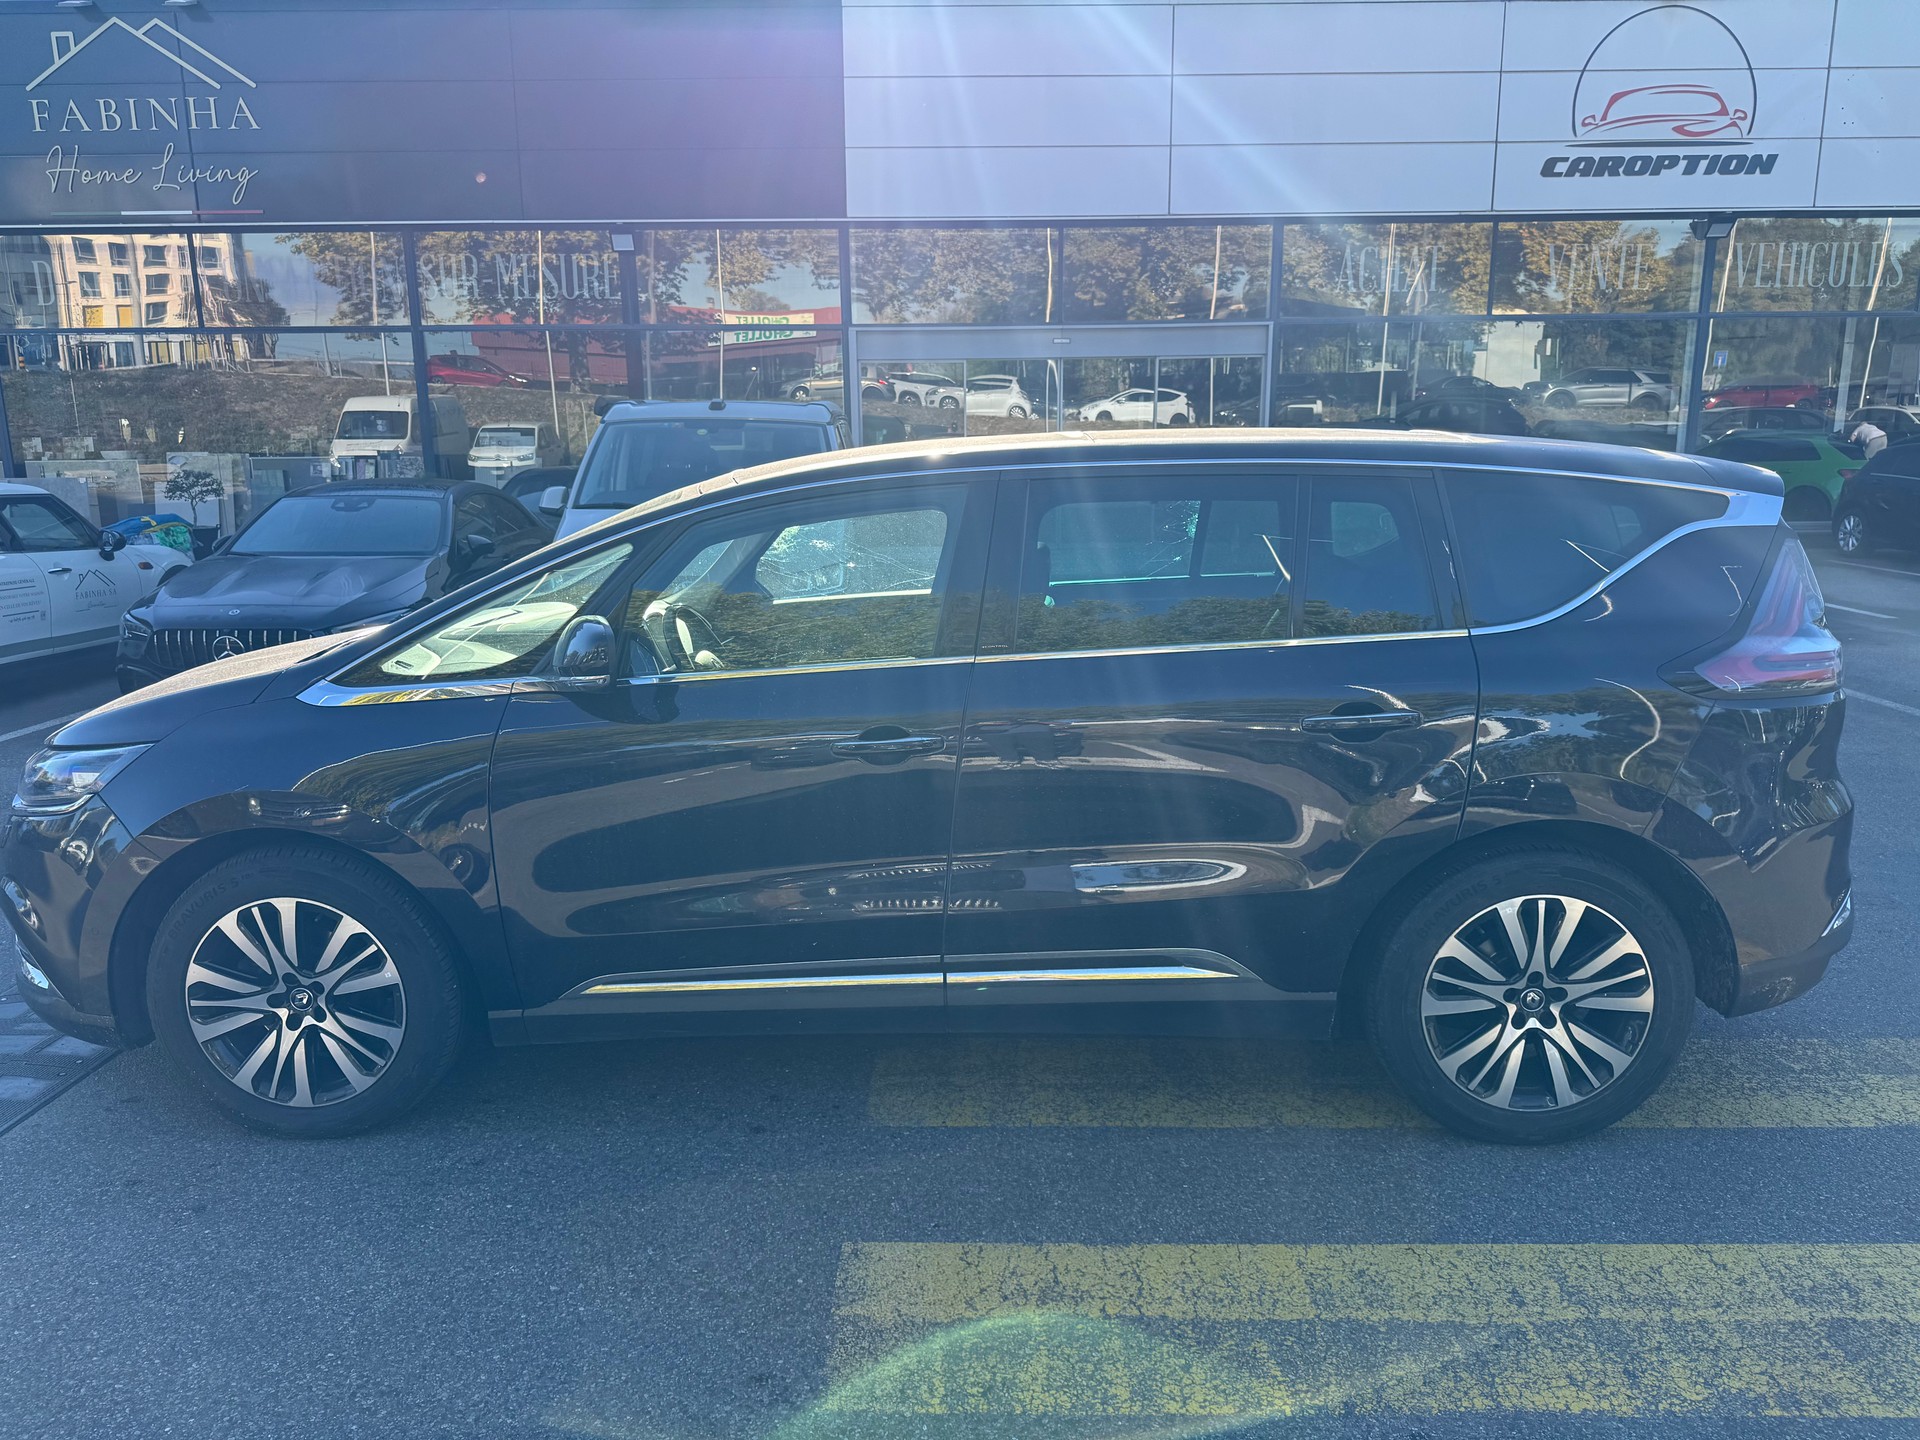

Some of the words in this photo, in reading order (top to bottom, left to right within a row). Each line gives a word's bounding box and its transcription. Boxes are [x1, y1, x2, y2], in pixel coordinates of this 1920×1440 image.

[28, 96, 261, 132] FABINHA
[46, 144, 142, 193] Home
[152, 143, 259, 205] Living
[1539, 153, 1779, 178] CAROPTION
[1336, 244, 1443, 292] ACHAT
[1548, 244, 1656, 291] VENTE
[1734, 240, 1906, 289] VEHICULES
[75, 589, 107, 600] FABINHA
[108, 588, 117, 597] SA
[168, 881, 227, 940] BRAVURIS
[1416, 878, 1488, 940] BRAVURIS
